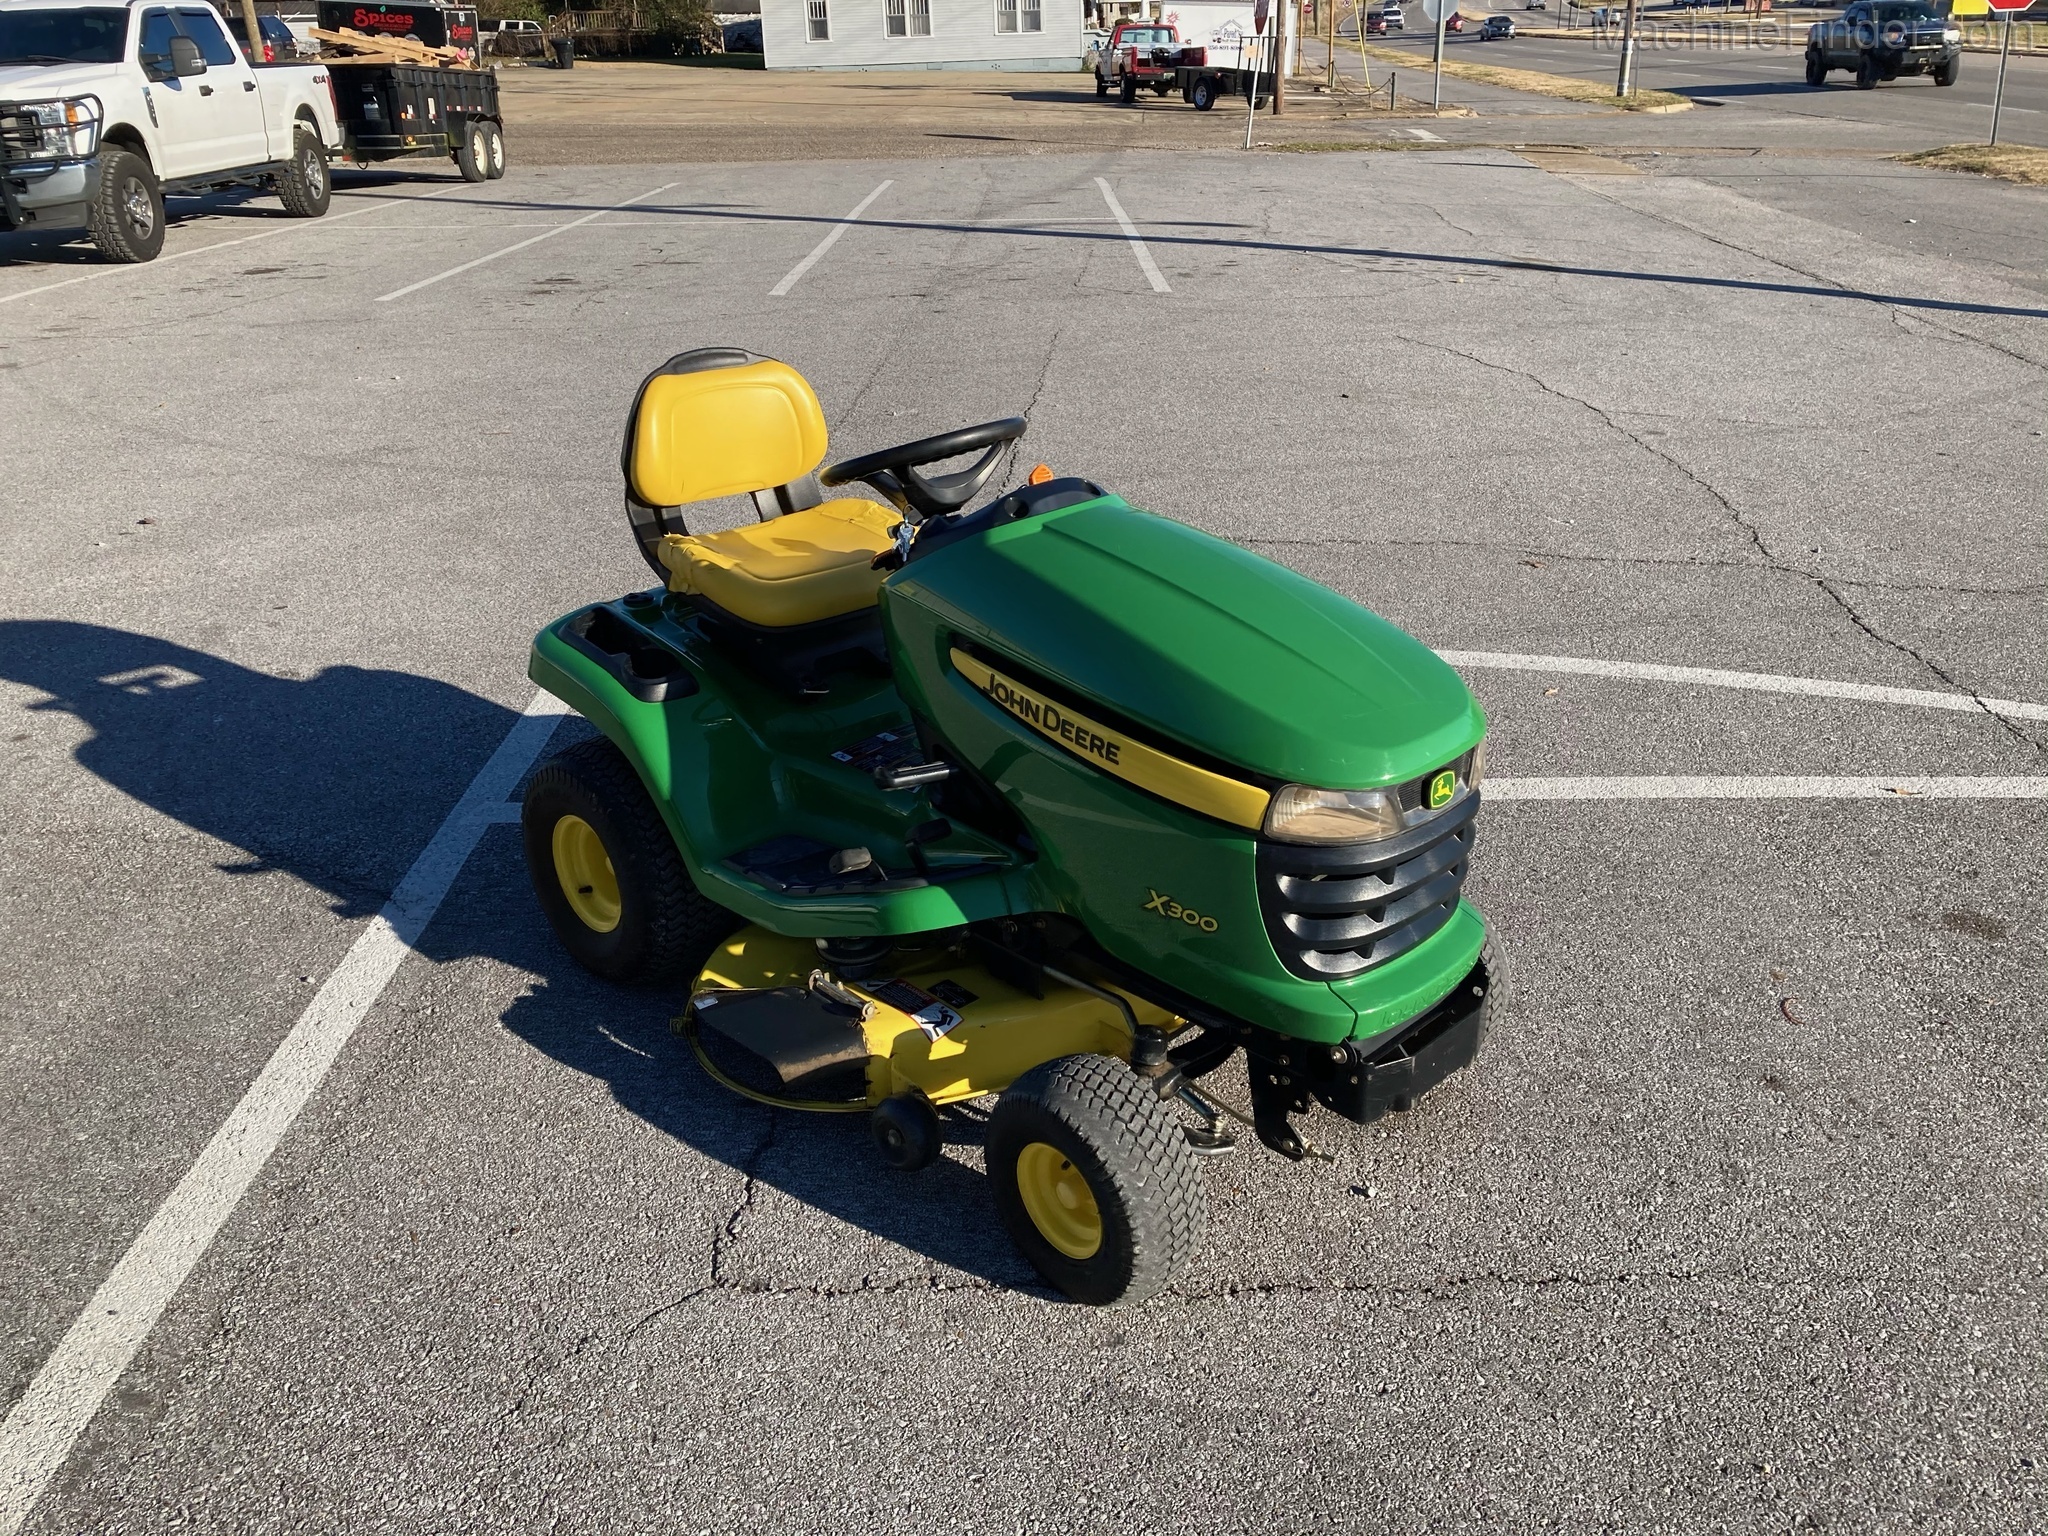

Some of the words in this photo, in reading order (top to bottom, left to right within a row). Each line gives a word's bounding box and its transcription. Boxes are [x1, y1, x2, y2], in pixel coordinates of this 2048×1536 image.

[353, 9, 414, 27] Spices
[982, 673, 1040, 723] JOHN
[1042, 704, 1121, 766] DEERE
[1143, 888, 1218, 932] X300
